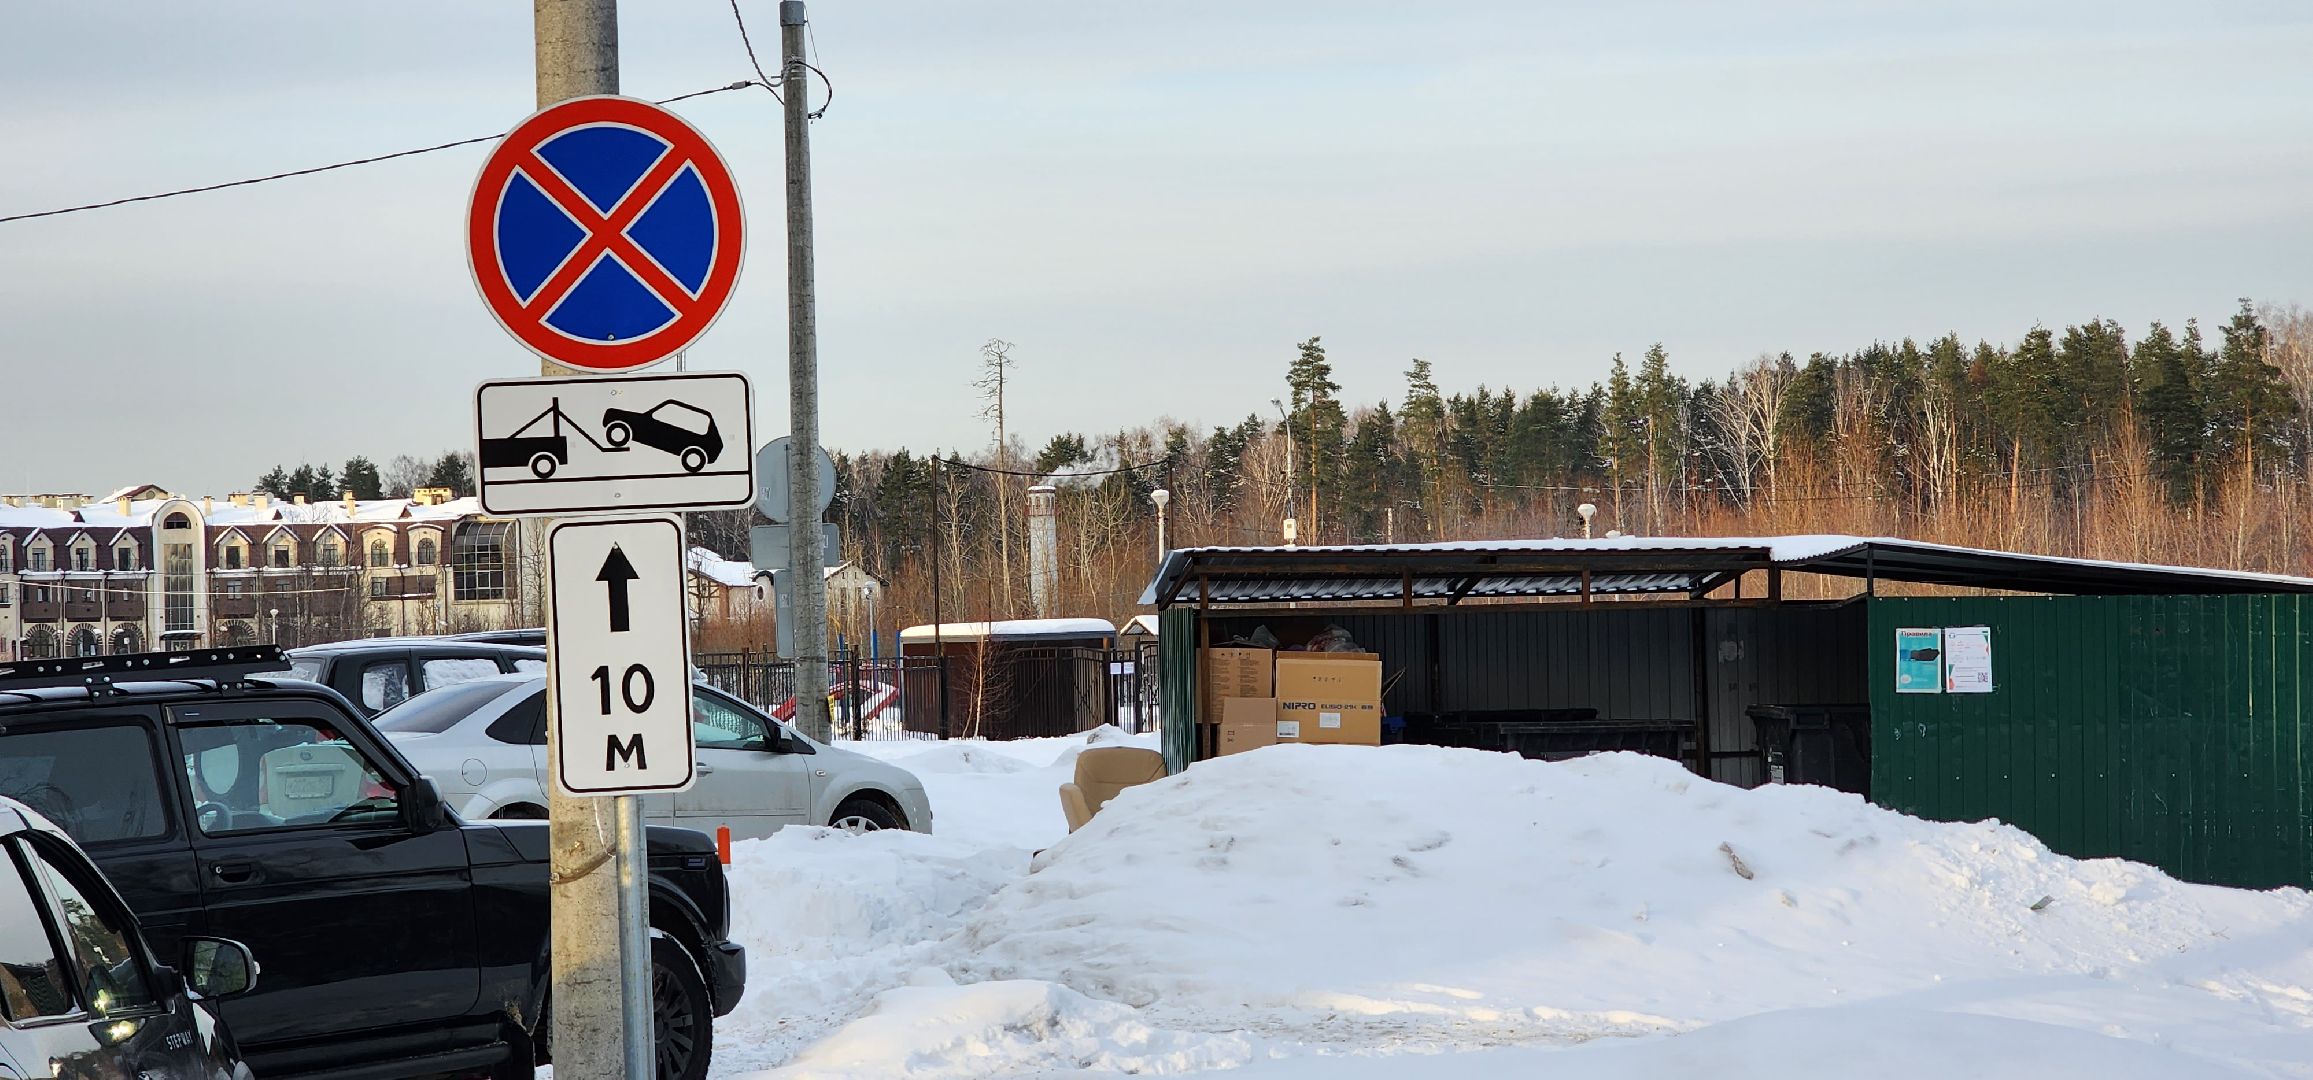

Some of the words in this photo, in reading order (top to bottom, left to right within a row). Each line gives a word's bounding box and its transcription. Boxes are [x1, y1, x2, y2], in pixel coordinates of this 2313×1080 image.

[590, 663, 655, 715] 10
[1282, 702, 1317, 710] NIPRO
[605, 733, 647, 771] М
